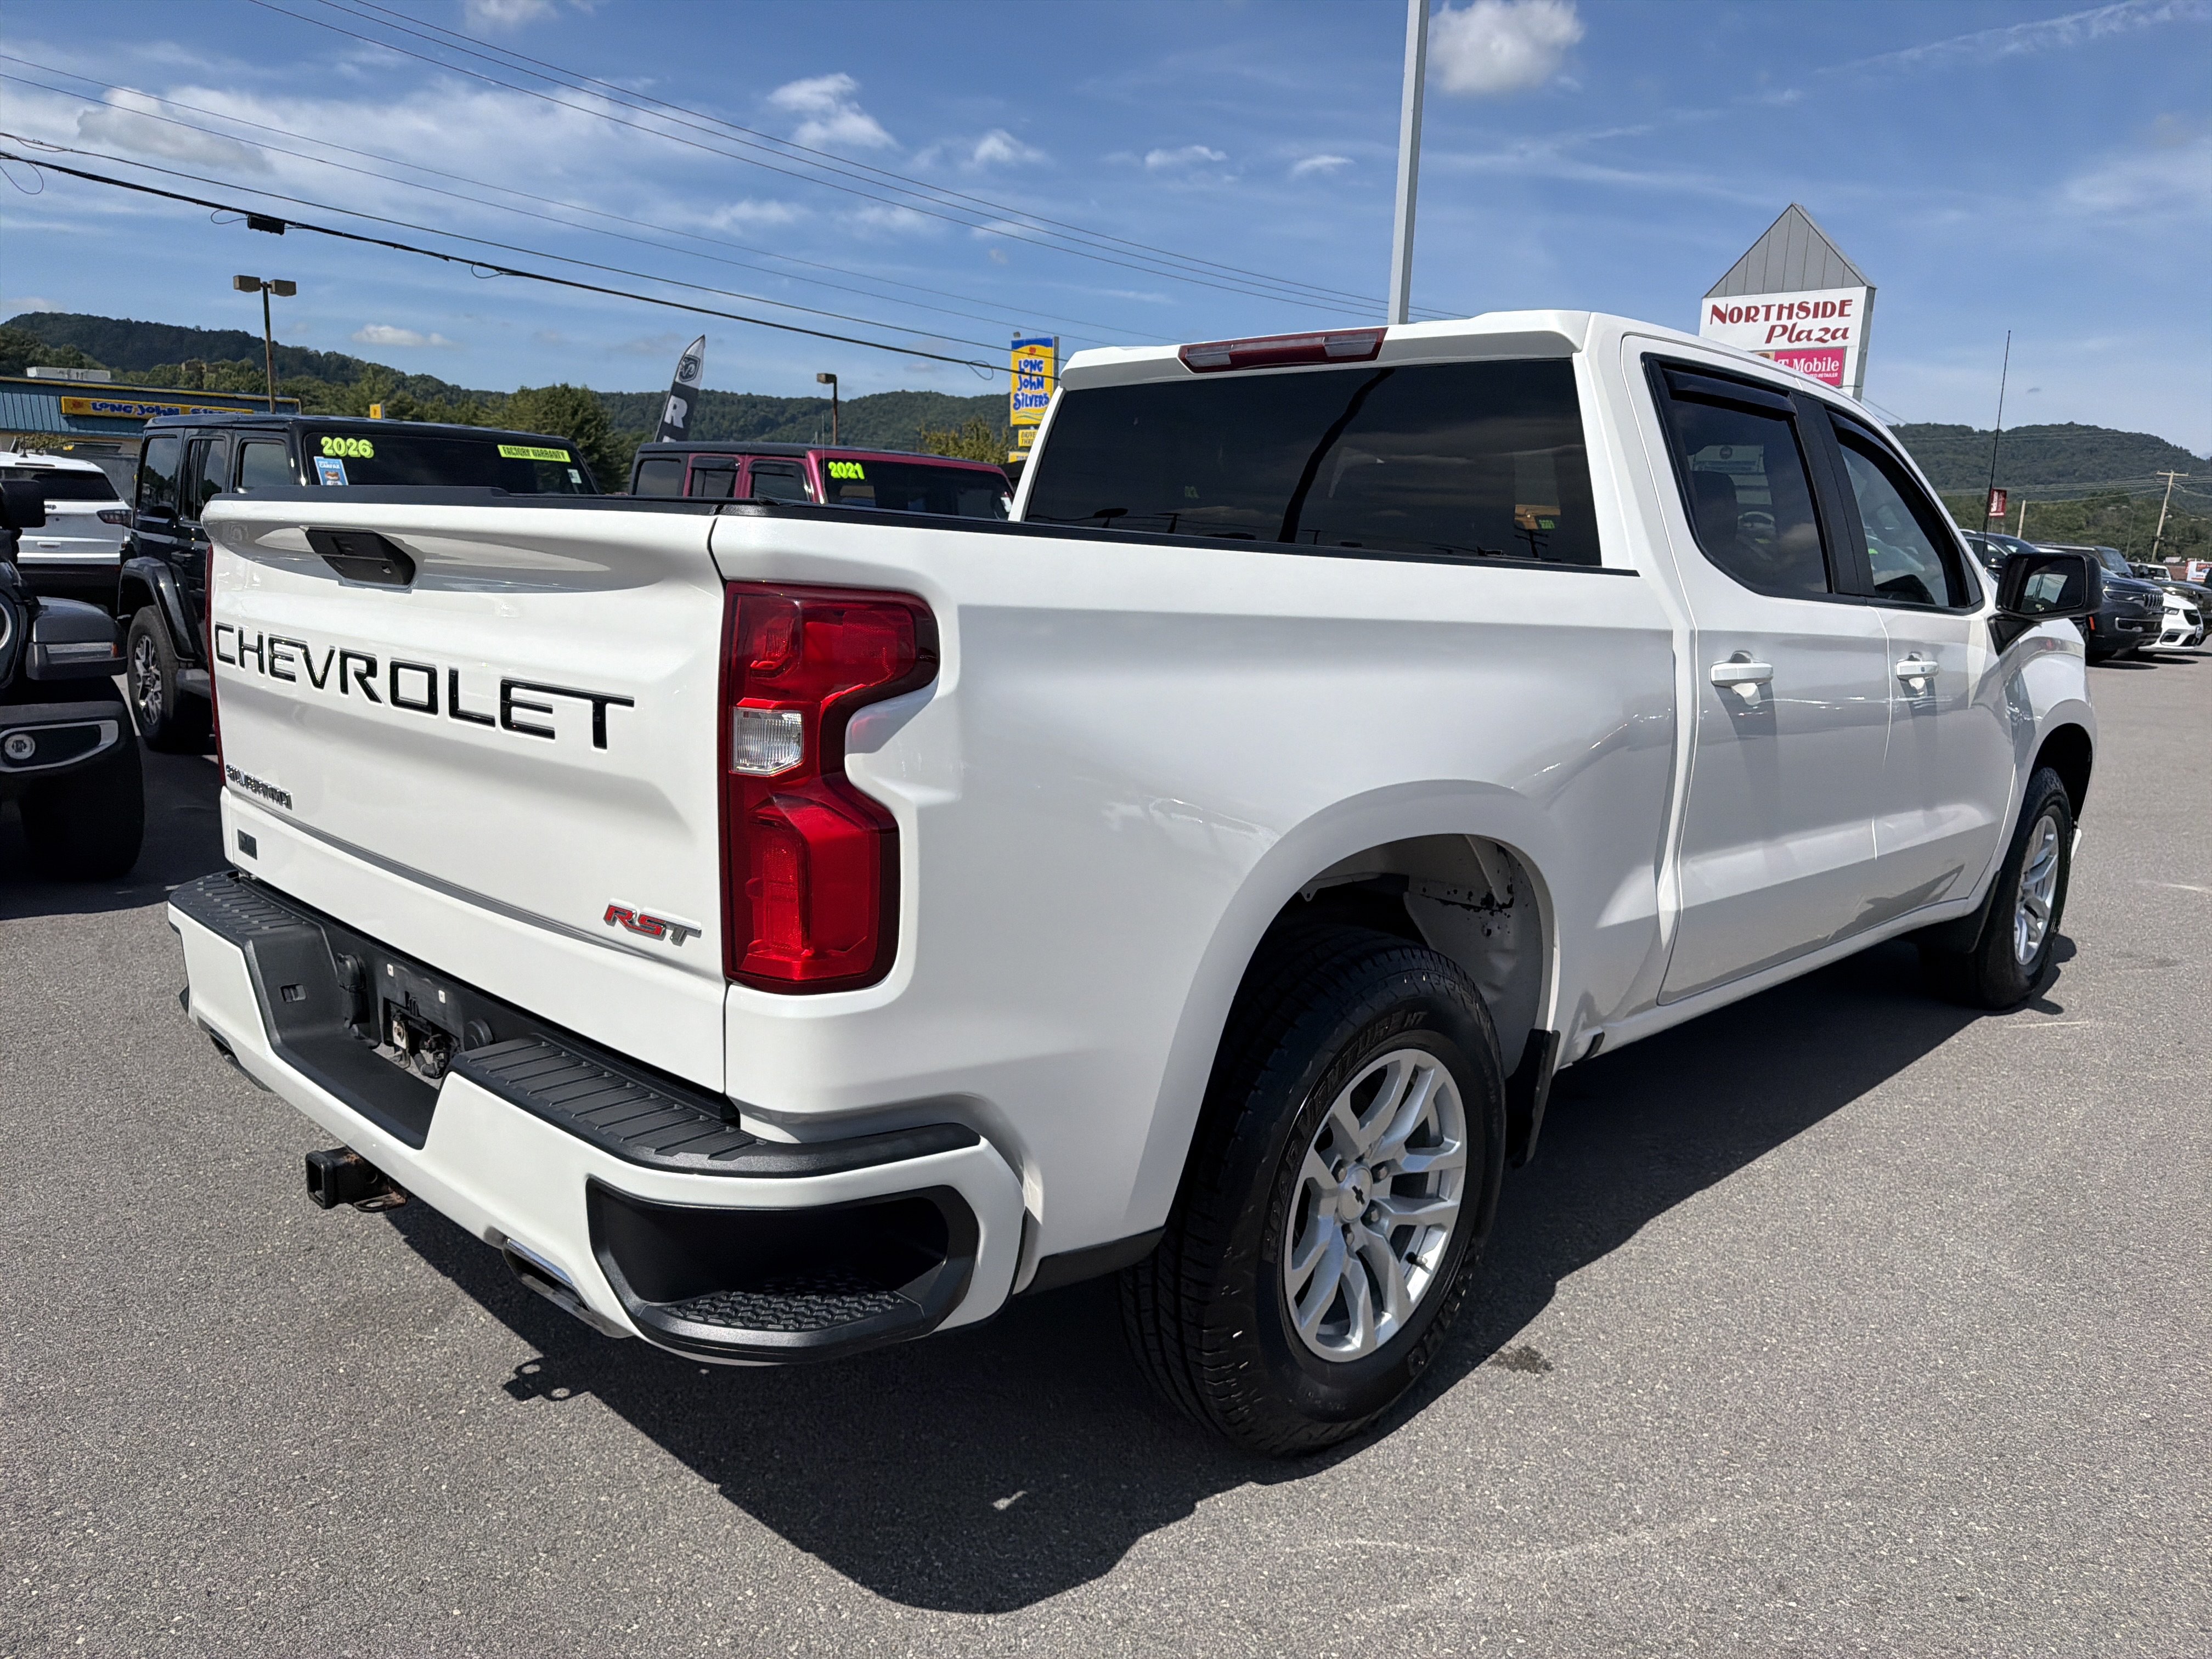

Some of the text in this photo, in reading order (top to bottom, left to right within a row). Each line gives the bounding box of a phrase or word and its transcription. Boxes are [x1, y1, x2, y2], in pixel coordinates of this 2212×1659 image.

[1710, 299, 1853, 325] NORTHSIDE
[1765, 322, 1849, 343] Plaza
[1018, 359, 1044, 373] LONG
[91, 402, 133, 414] LONG
[321, 437, 374, 458] 2026
[828, 461, 865, 479] 2021
[215, 621, 635, 751] CHEVROLET
[602, 902, 702, 947] RST
